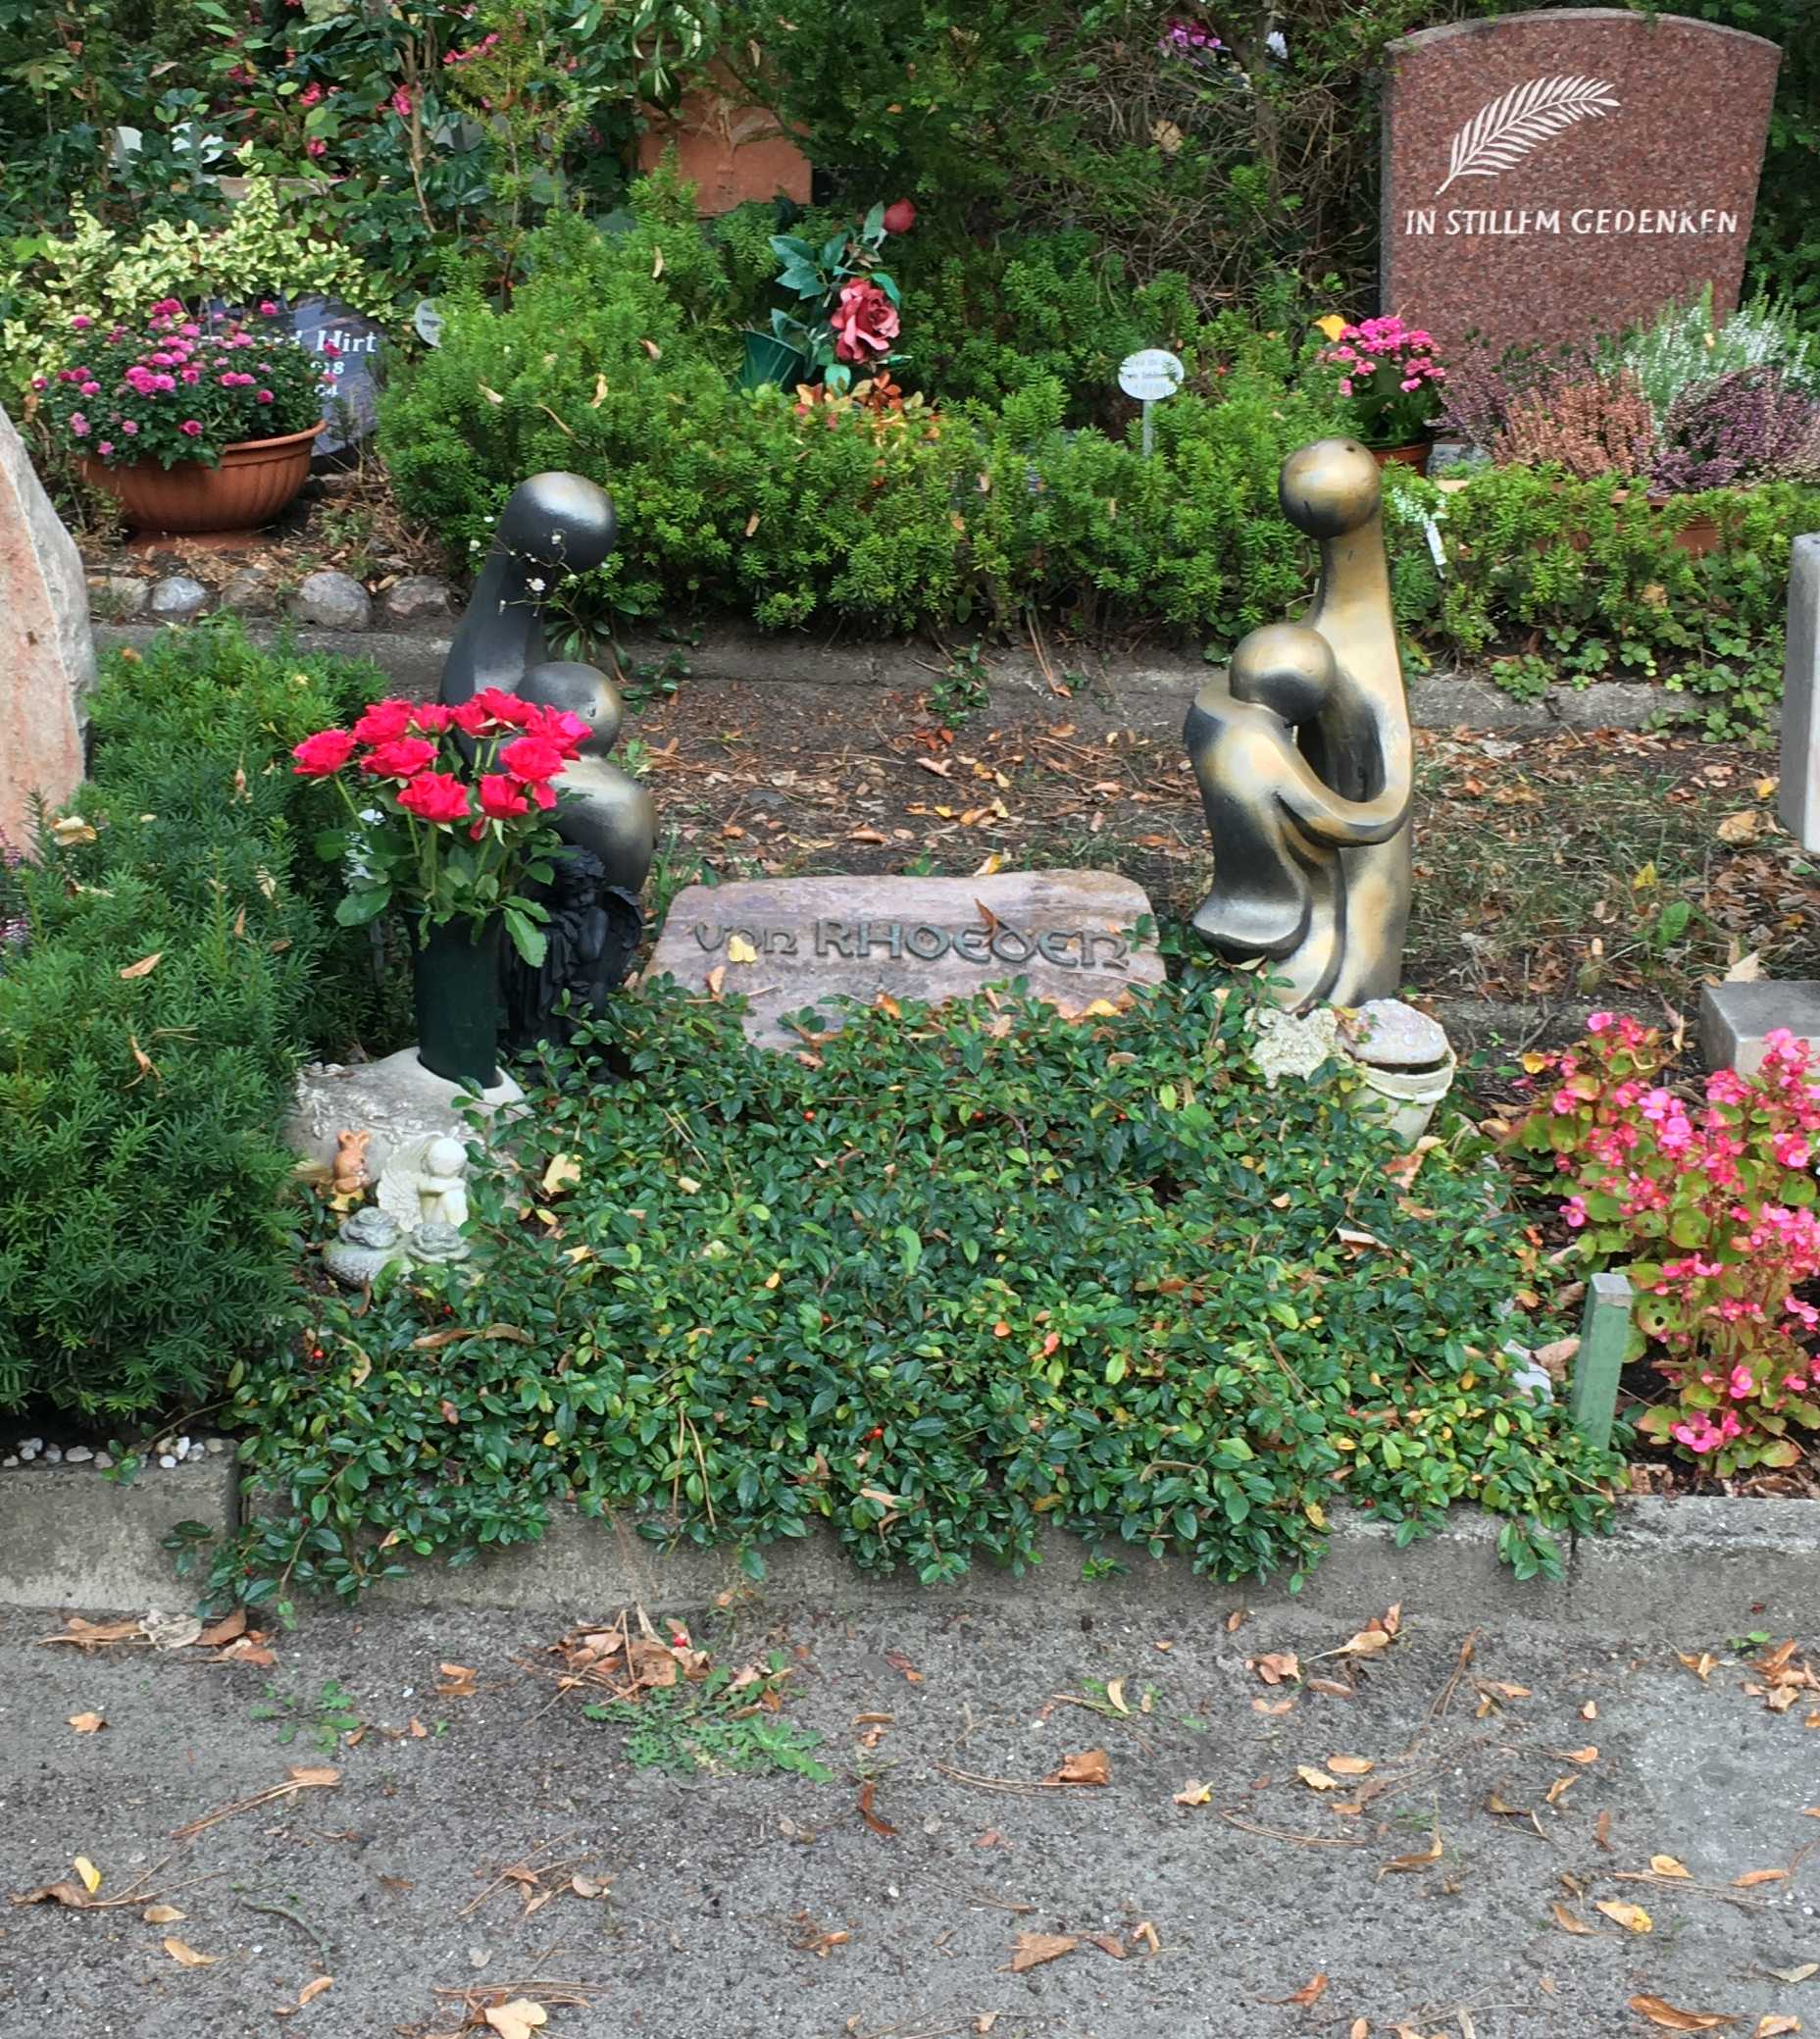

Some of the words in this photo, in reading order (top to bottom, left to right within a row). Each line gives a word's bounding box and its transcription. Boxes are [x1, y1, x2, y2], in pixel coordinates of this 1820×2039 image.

[1405, 209, 1437, 235] IN
[1444, 209, 1561, 235] STILLEM
[1571, 208, 1738, 234] GEDENKEN
[316, 330, 377, 353] Hirt
